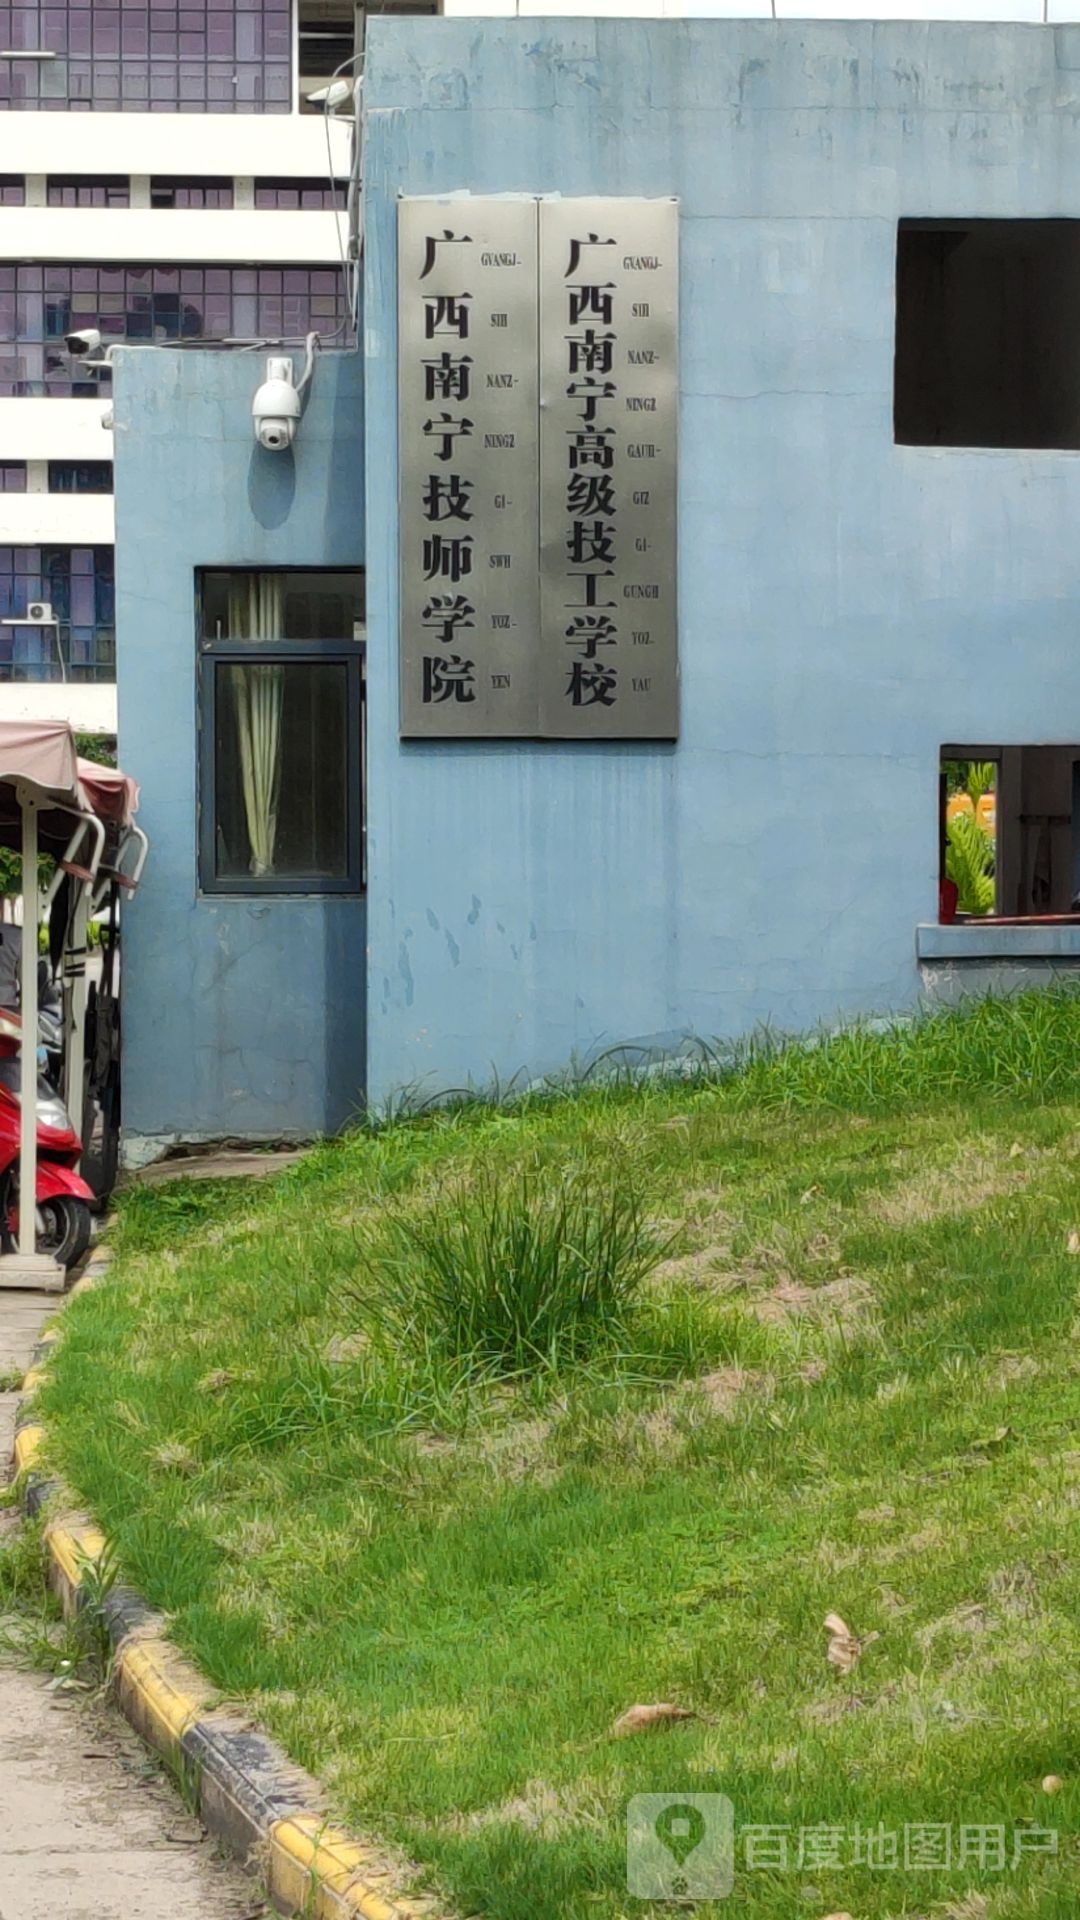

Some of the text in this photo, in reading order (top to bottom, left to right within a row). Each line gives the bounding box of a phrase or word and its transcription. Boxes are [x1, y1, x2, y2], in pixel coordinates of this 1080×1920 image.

[631, 302, 650, 318] SIH
[490, 313, 508, 328] SIH
[418, 228, 476, 704] 广西南宁技师学院
[563, 232, 618, 708] 广西南宁高级技工学校
[632, 491, 650, 505] GIZ
[489, 554, 511, 569] SWH
[490, 674, 511, 689] YEN
[631, 678, 651, 692] YAU
